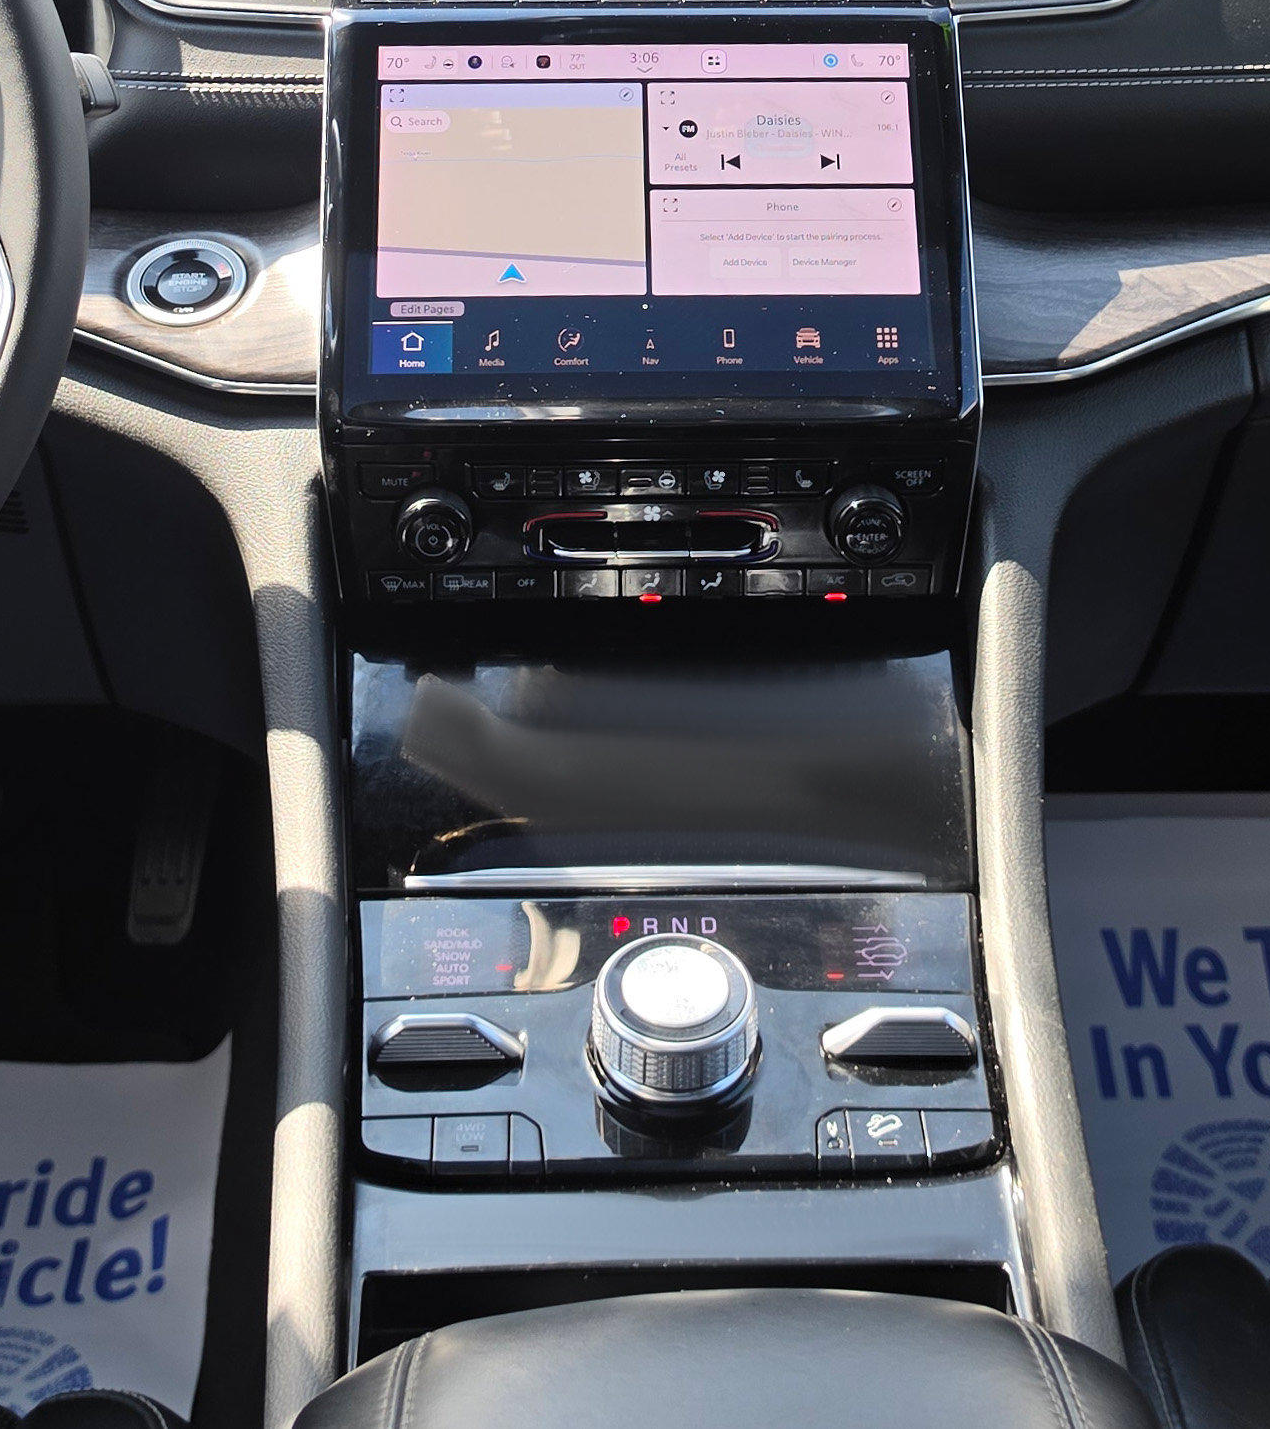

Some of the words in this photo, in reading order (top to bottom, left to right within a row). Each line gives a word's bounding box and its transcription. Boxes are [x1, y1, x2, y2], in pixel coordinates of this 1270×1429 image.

[629, 52, 660, 64] 3:06
[878, 55, 902, 67] 70°
[386, 57, 410, 69] 70°
[408, 117, 443, 127] Search
[756, 114, 801, 126] Daisies
[681, 125, 695, 133] FM
[877, 123, 899, 132] 106.1
[706, 128, 734, 140] Justin
[736, 128, 770, 139] Bieber
[777, 128, 813, 139] Daisies
[821, 128, 852, 139] WIN...
[674, 152, 687, 161] All
[664, 163, 698, 173] Presets
[766, 202, 800, 212] Phone
[699, 232, 725, 242] Select
[786, 233, 805, 242] start
[806, 233, 819, 242] the
[820, 233, 848, 243] pairing
[722, 258, 739, 267] Add
[740, 258, 768, 267] Device
[792, 258, 819, 268] Device
[820, 258, 857, 270] Manager
[172, 285, 204, 293] STOP
[401, 305, 421, 314] Edit
[423, 305, 455, 316] Pages
[399, 359, 425, 368] Home
[479, 358, 505, 367] Media
[554, 357, 589, 366] Comfort
[642, 356, 660, 365] Nav
[716, 356, 744, 365] Phone
[793, 355, 824, 365] Vehicle
[877, 356, 899, 366] Apps
[895, 470, 931, 479] SCREEN
[382, 478, 409, 487] MUTE
[905, 478, 923, 487] OFF
[426, 523, 440, 531] VOL
[861, 519, 882, 527] TUNE
[463, 579, 489, 588] REAR
[517, 578, 535, 587] OFF
[827, 576, 845, 584] A/C
[403, 581, 426, 589] MAX
[613, 917, 630, 935] P
[643, 918, 658, 934] R
[672, 918, 688, 933] N
[701, 917, 718, 933] D
[436, 929, 469, 938] ROCK
[424, 940, 482, 951] SAND/MUD
[434, 952, 471, 962] SNOW
[436, 963, 469, 973] AUTO
[1100, 926, 1232, 1009] We
[433, 975, 470, 986] SPORT
[1089, 1023, 1172, 1101] In
[455, 1132, 485, 1141] LOW
